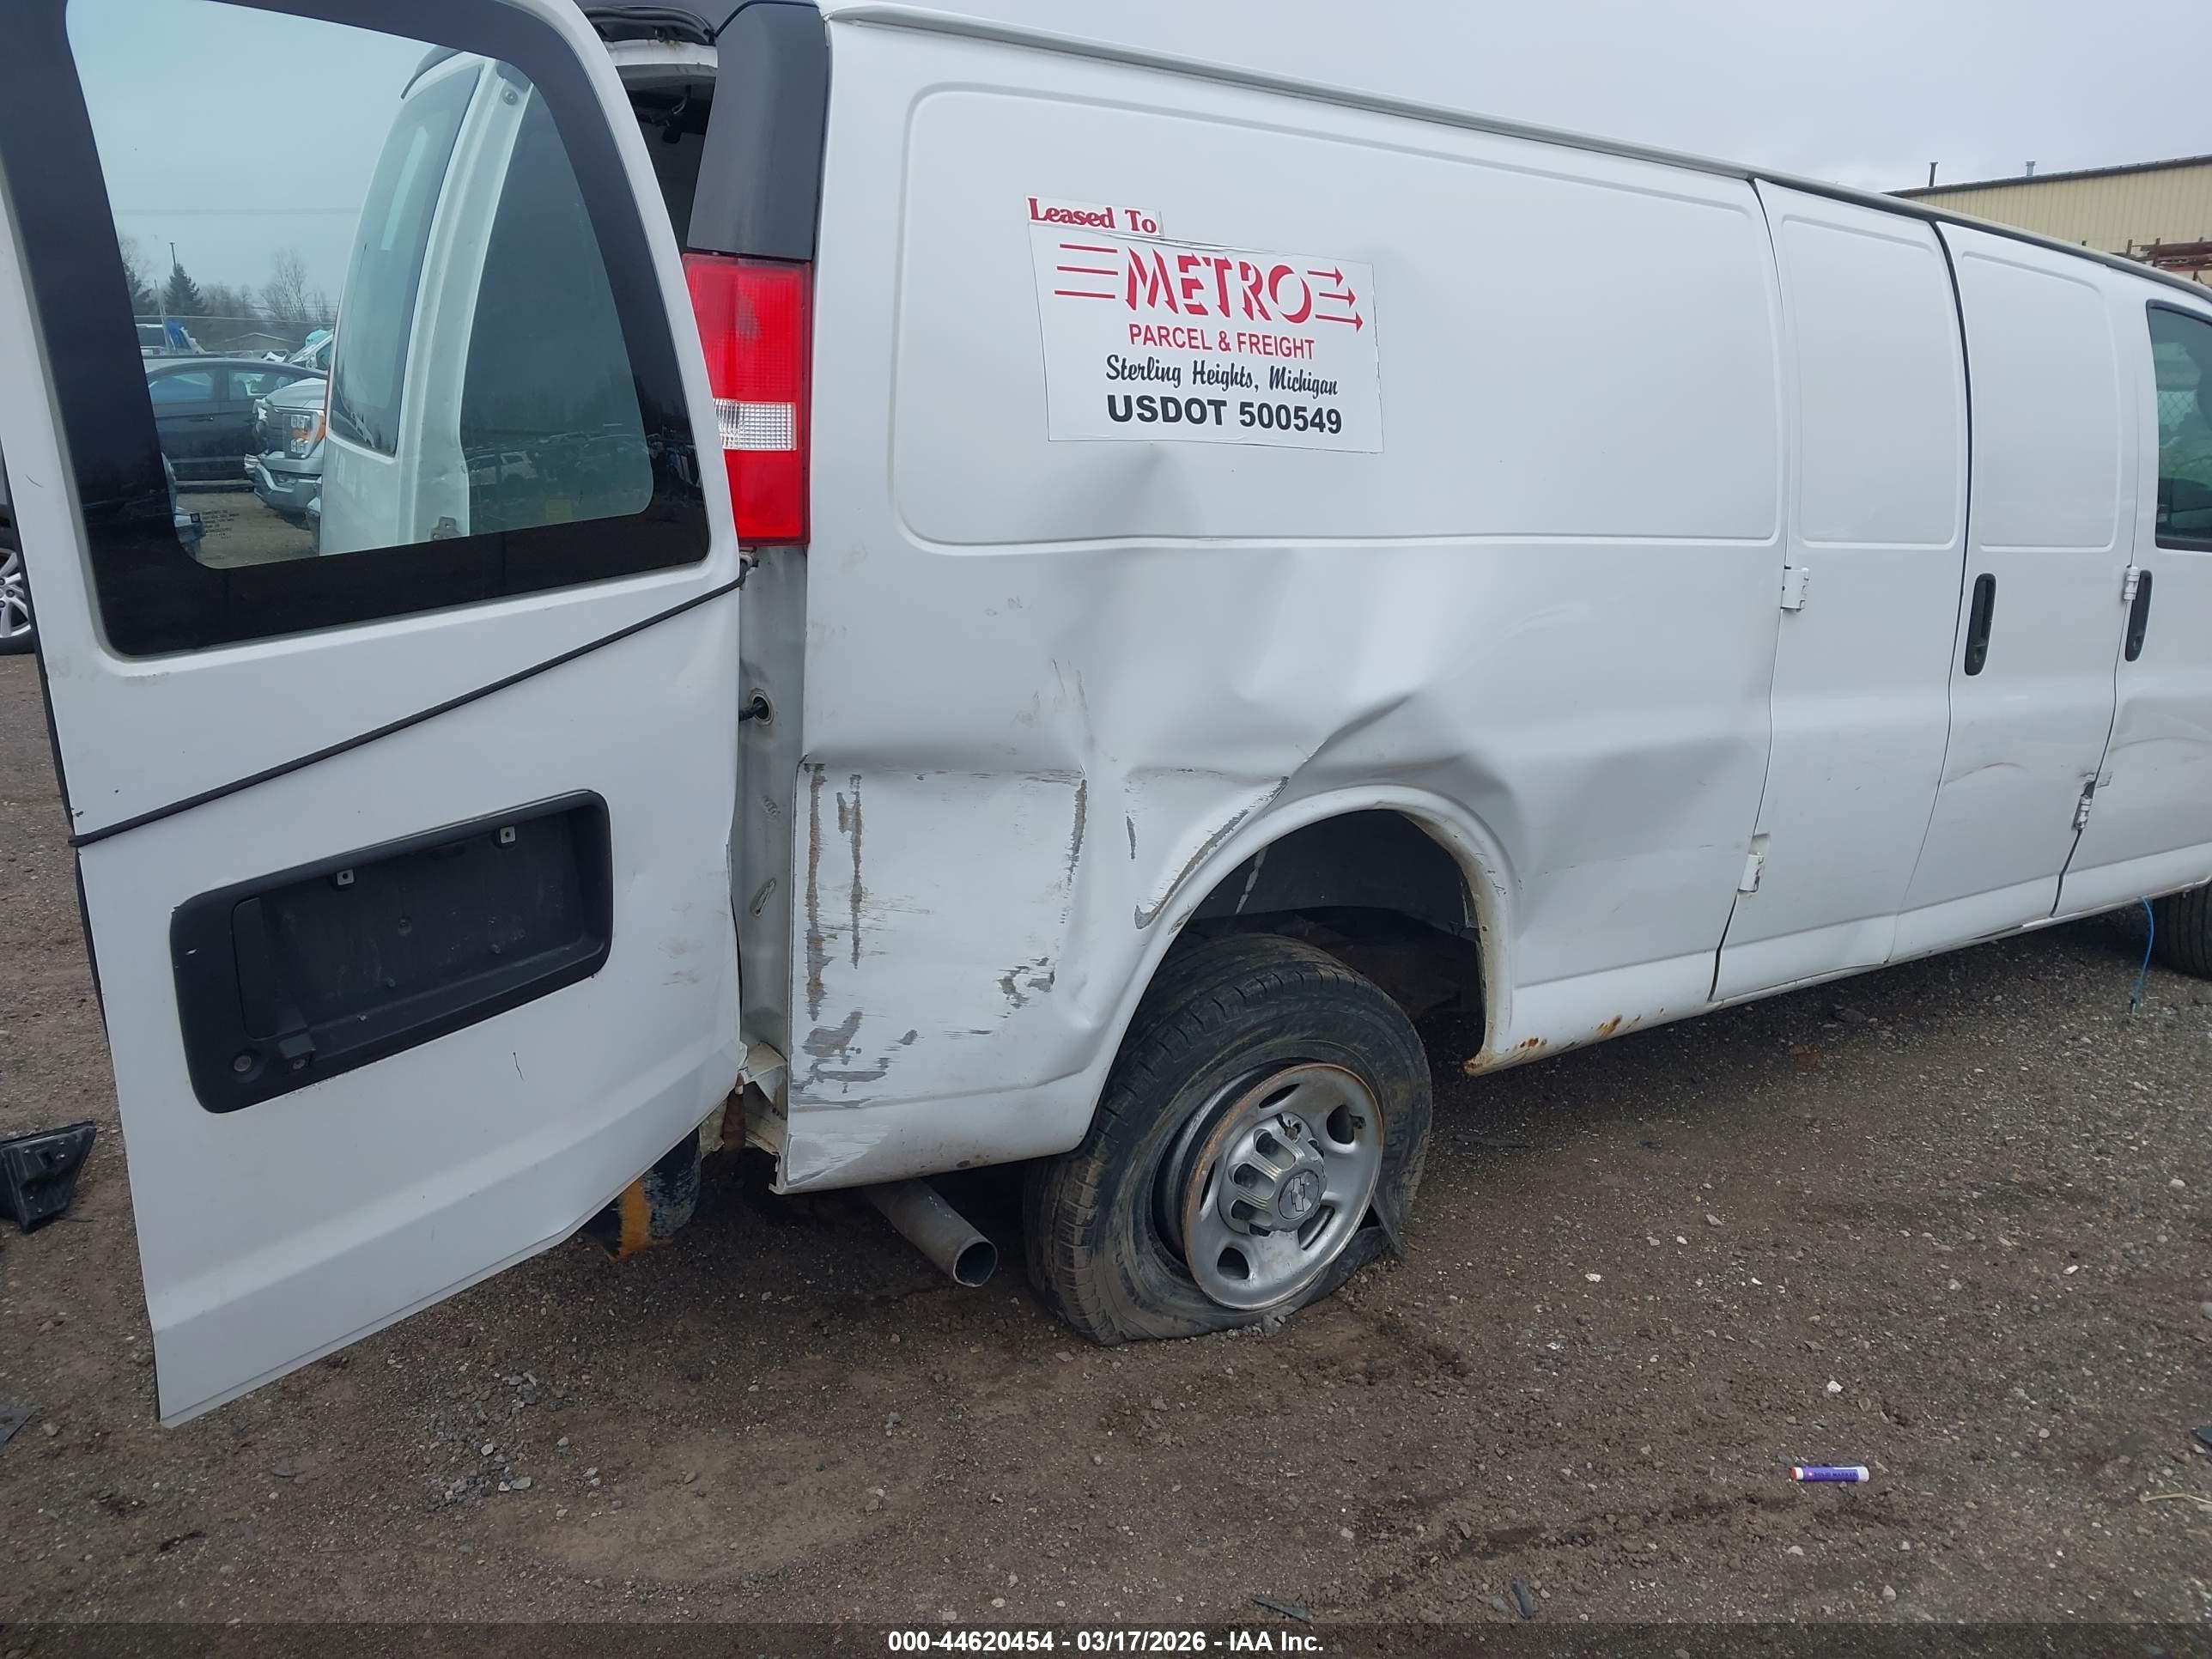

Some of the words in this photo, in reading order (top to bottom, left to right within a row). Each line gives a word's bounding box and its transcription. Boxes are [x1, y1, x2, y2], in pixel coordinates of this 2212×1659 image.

[1028, 198, 1115, 228] Leased
[1125, 210, 1157, 234] To
[1126, 246, 1311, 324] METRO
[1128, 323, 1212, 350] PARCEL
[1218, 331, 1231, 352] &
[1237, 332, 1315, 359] FREIGHT
[1106, 355, 1182, 388] Sterling
[1192, 360, 1259, 392] Heights,
[1269, 365, 1338, 398] Michigan
[1107, 394, 1227, 426] USDOT
[1239, 401, 1341, 434] 500549
